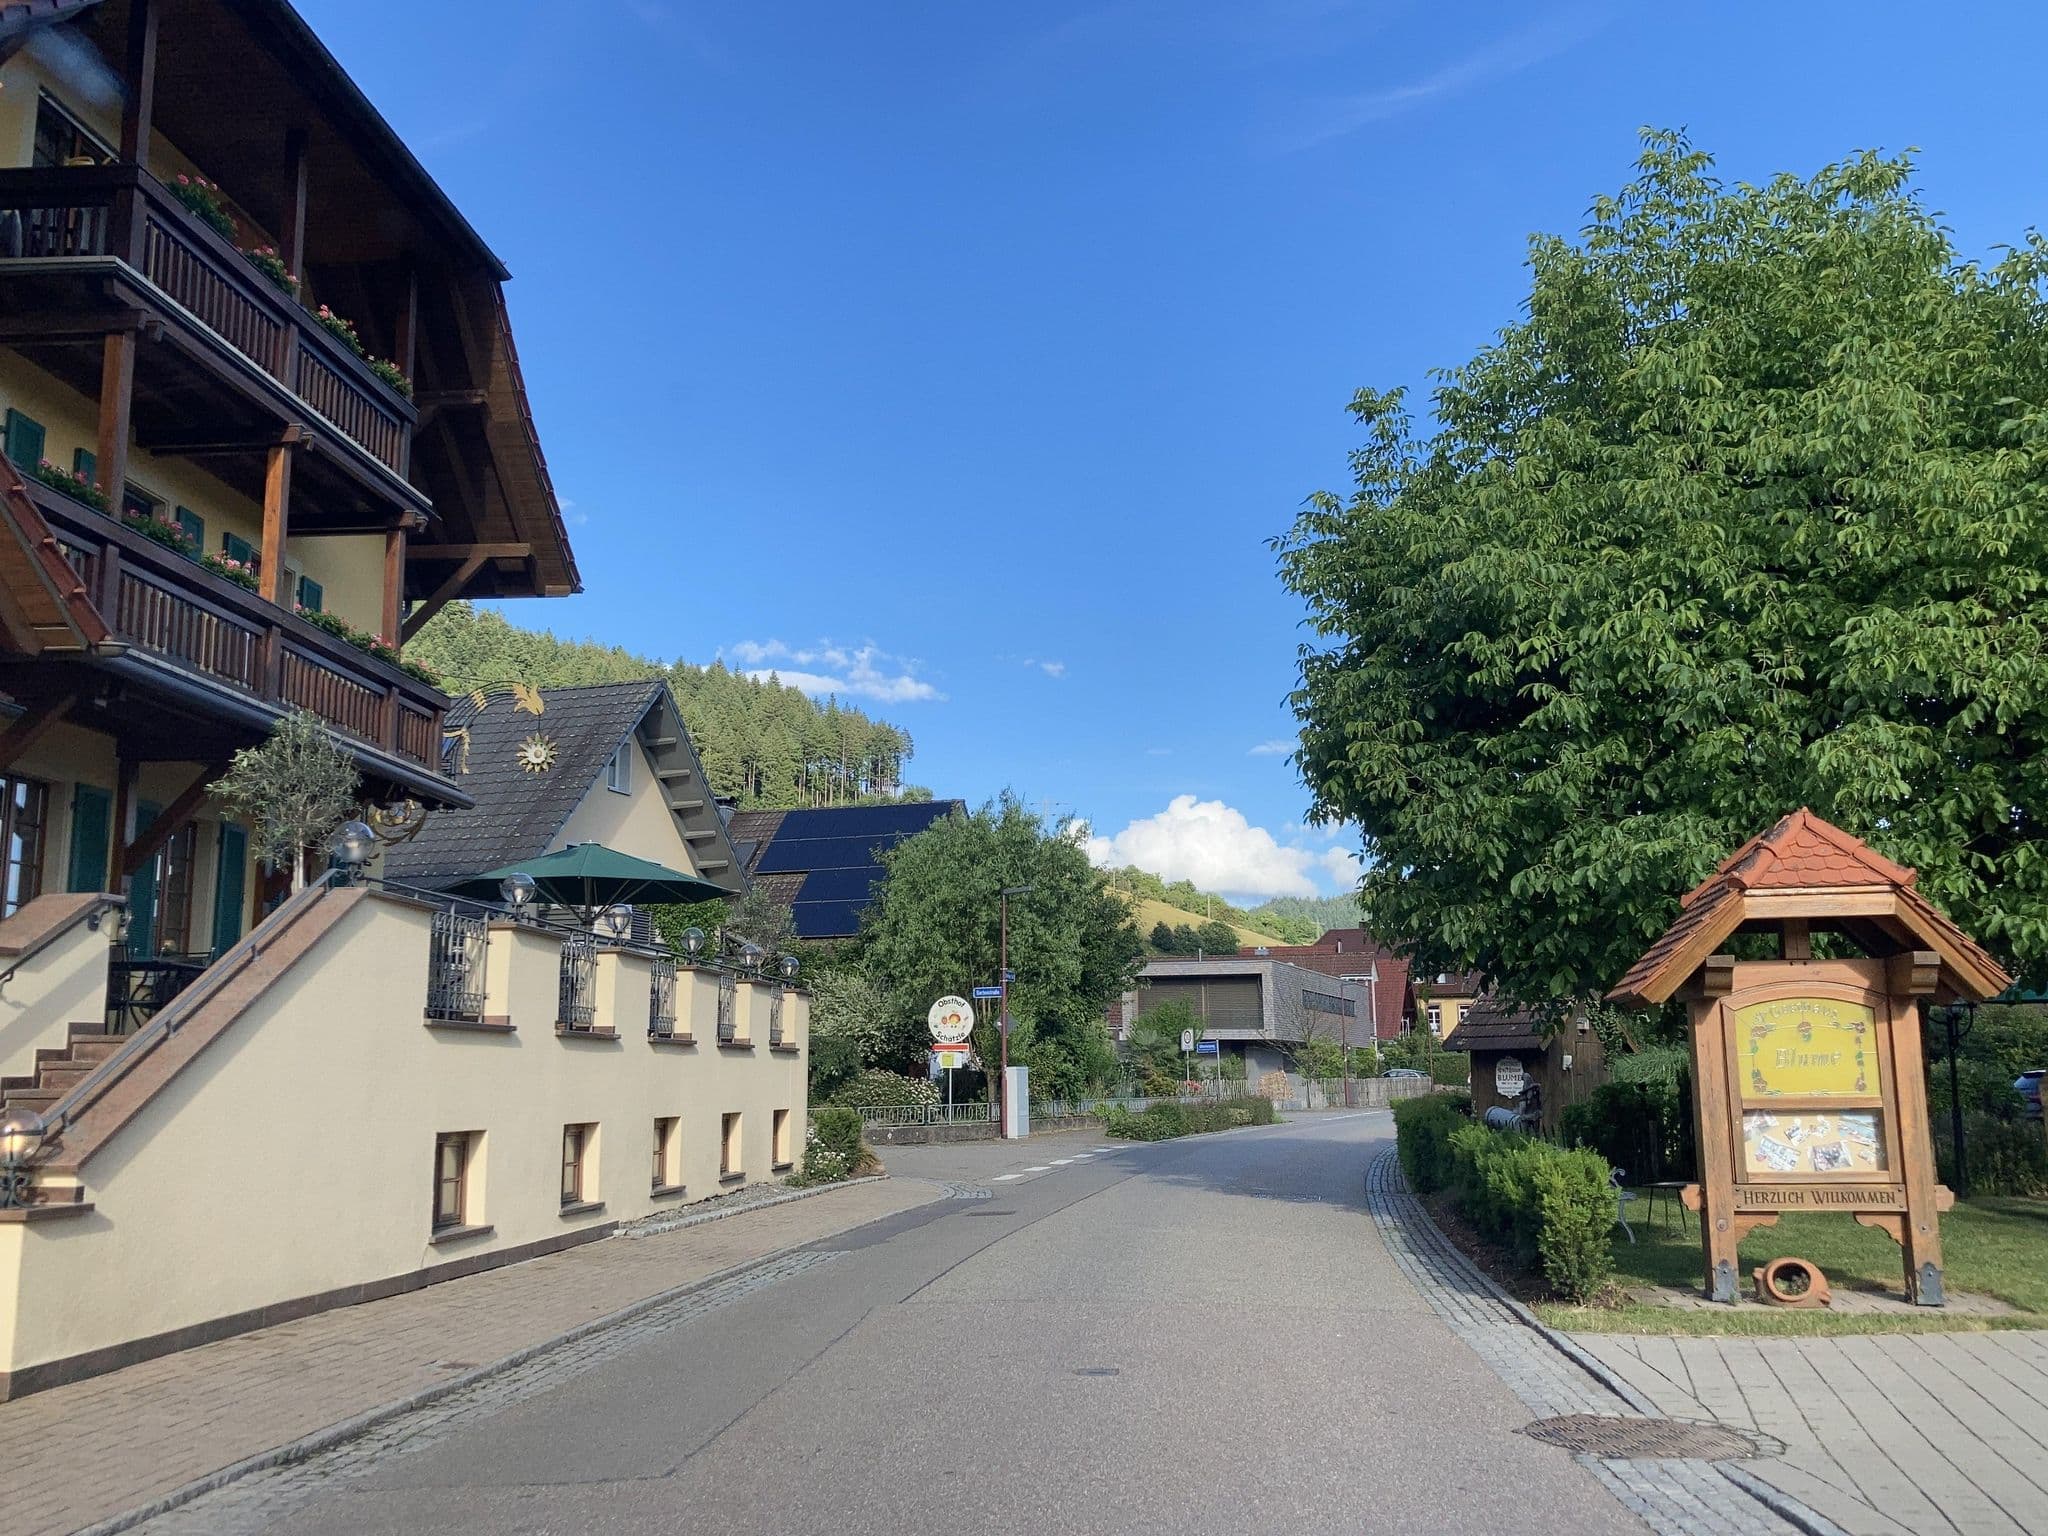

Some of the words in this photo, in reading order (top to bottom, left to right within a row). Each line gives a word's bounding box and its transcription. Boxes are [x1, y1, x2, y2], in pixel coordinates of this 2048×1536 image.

[938, 998, 966, 1007] Obsthof
[1743, 1190, 1804, 1204] HERZLICH
[1811, 1190, 1896, 1204] WILLKOMMEN
